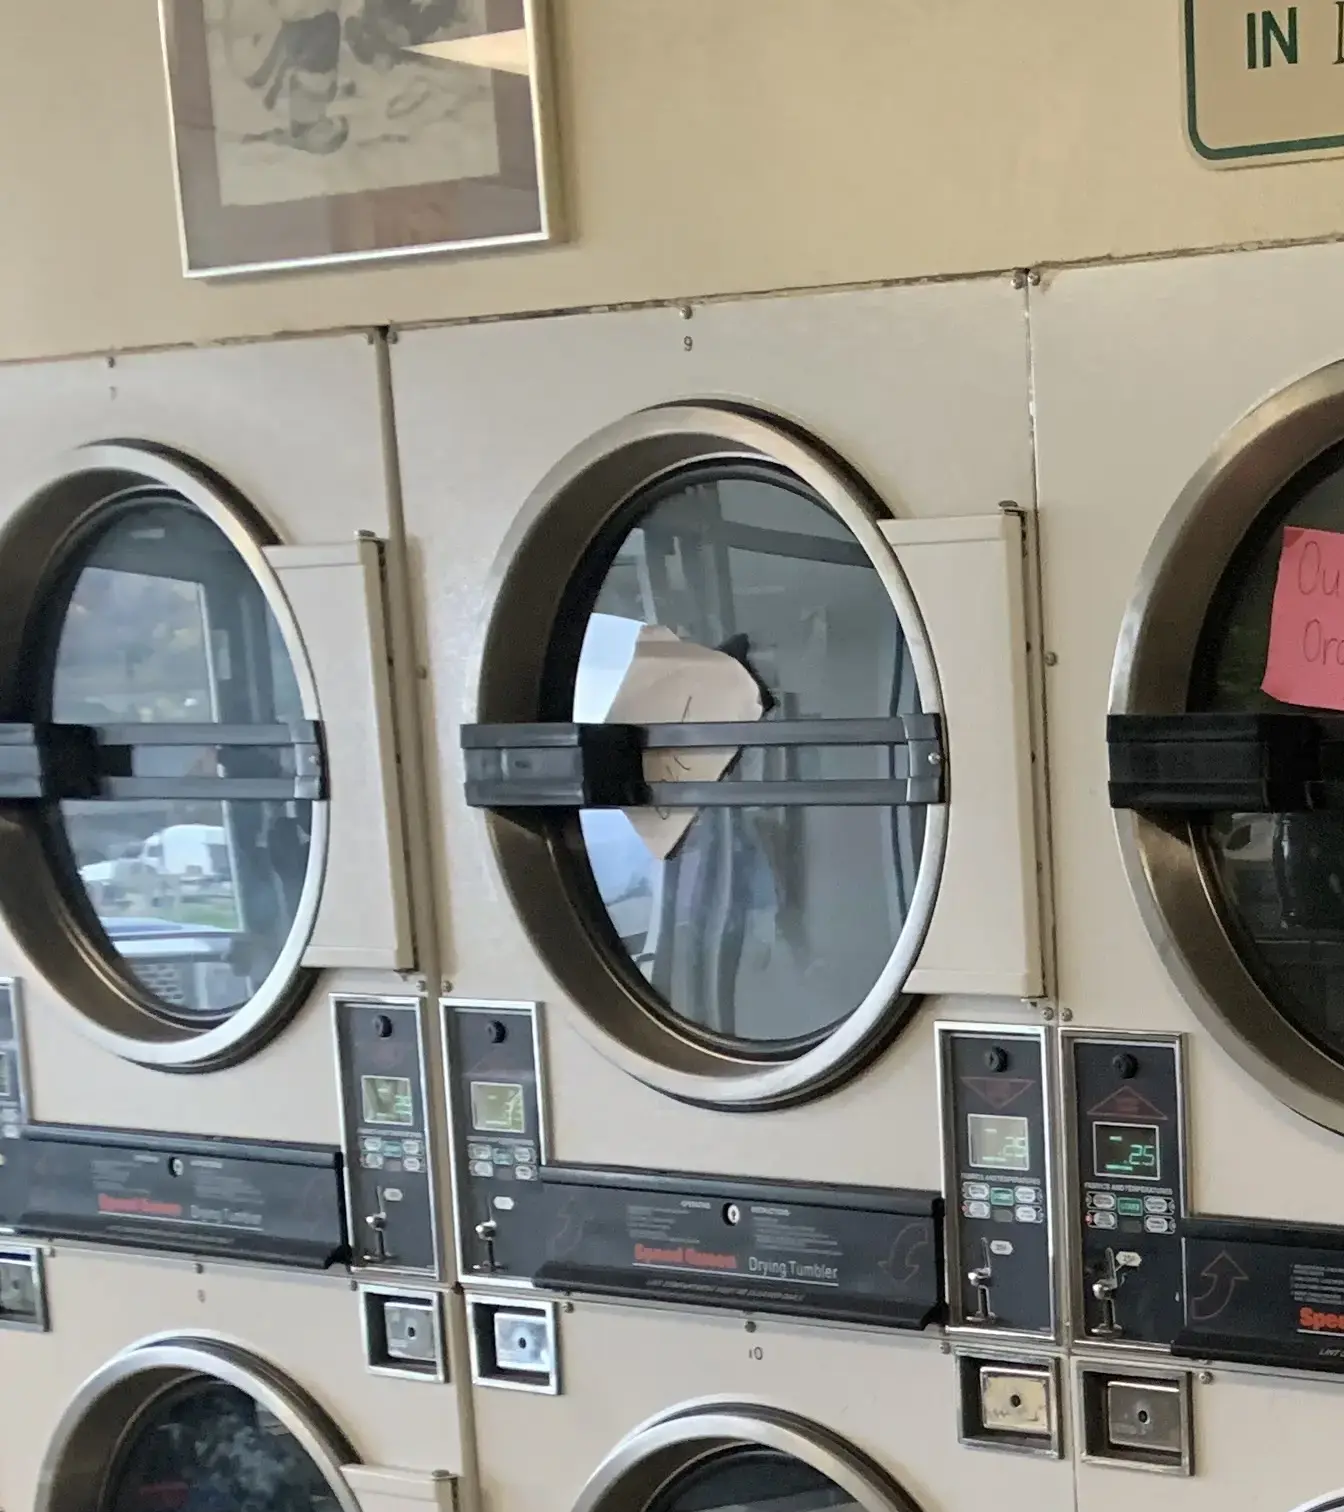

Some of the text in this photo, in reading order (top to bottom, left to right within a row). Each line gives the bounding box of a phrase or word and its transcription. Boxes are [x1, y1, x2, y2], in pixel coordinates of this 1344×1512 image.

[1246, 6, 1298, 69] IN
[683, 335, 693, 352] 9
[749, 1256, 838, 1280] Drying Tumbler
